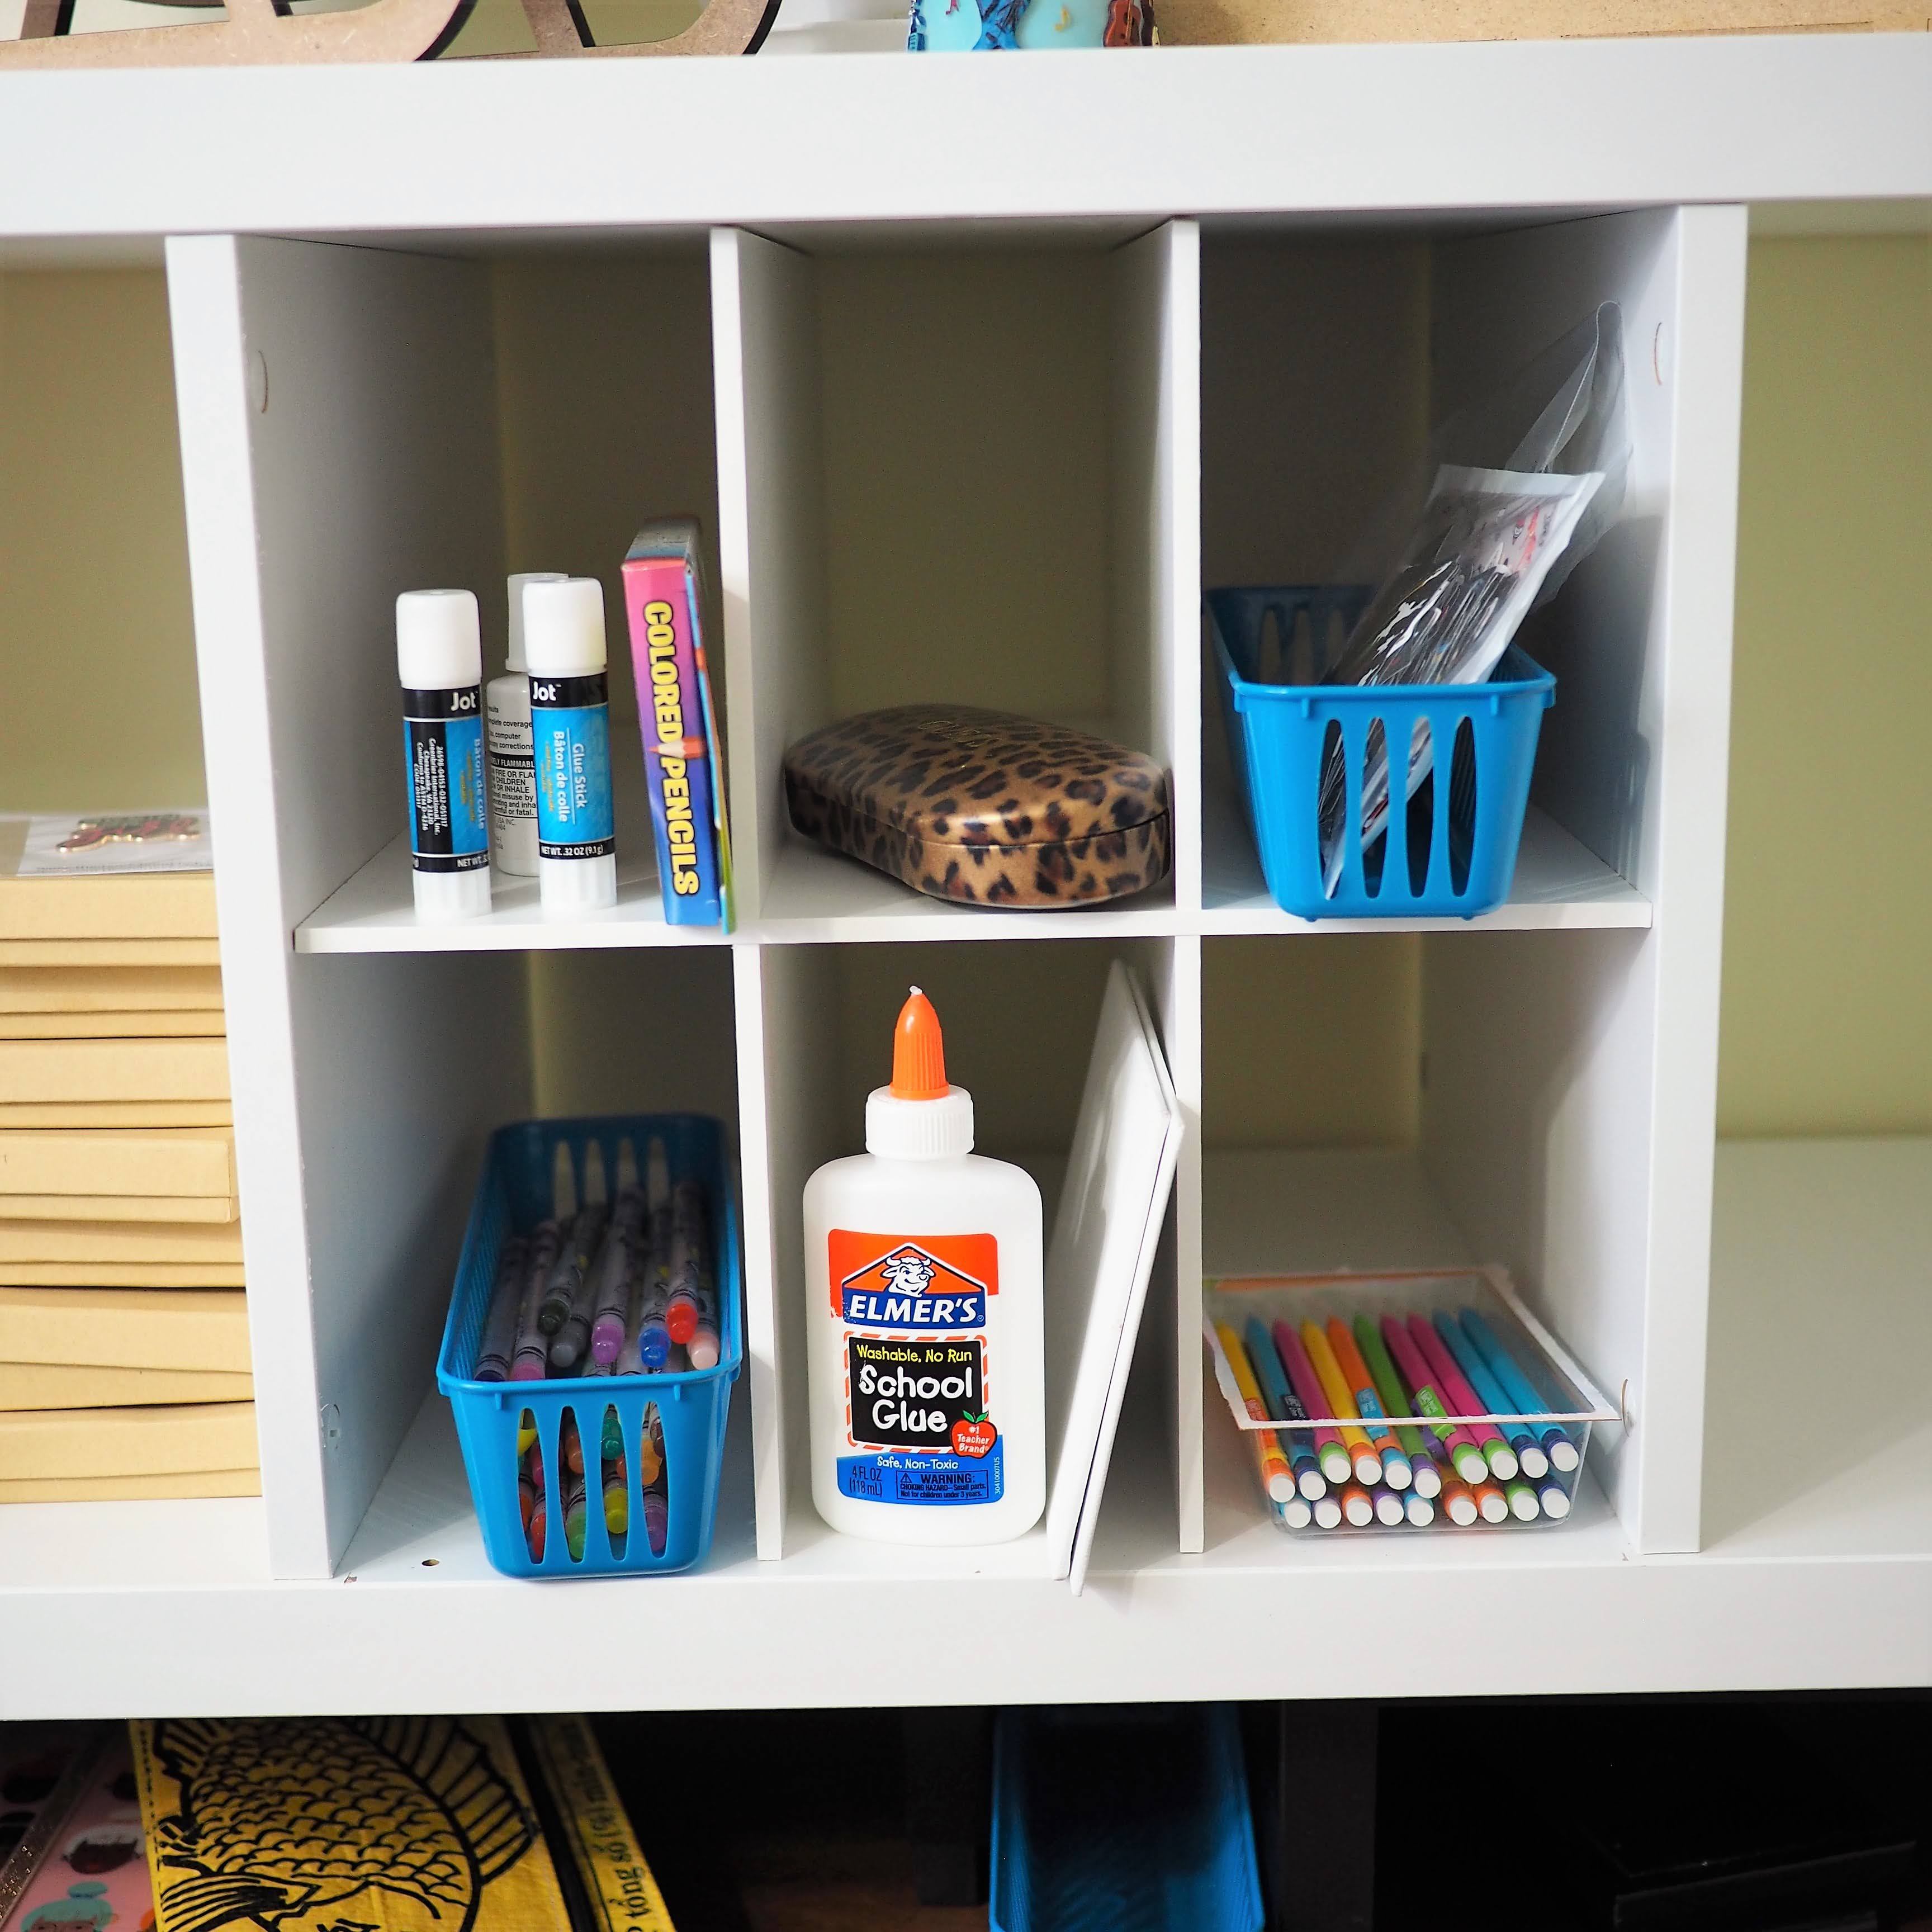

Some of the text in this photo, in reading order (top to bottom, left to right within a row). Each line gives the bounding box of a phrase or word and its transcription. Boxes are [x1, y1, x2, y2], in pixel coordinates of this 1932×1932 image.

[533, 681, 556, 701] Jot
[451, 692, 476, 711] Jot
[644, 600, 699, 896] COLORED PENCILS
[501, 759, 535, 768] FLAMMABL
[496, 776, 525, 786] CHILDREN
[553, 731, 570, 822] Bâton de colle
[572, 743, 588, 809] Glue Stick
[476, 780, 484, 793] de
[541, 846, 550, 854] NET
[574, 847, 585, 855] OZ
[849, 1294, 978, 1324] ELMER'S
[856, 1344, 972, 1363] Washable, No Run
[858, 1363, 973, 1399] School
[872, 1400, 948, 1433] Glue
[968, 1426, 980, 1434] #1
[956, 1433, 990, 1445] Teacher
[959, 1442, 986, 1453] Brand
[905, 1458, 959, 1470] Non-Toxic
[852, 1465, 882, 1481] 4 FL OZ
[921, 1473, 976, 1484] WARNING:
[849, 1477, 883, 1497] (118 mL)
[970, 1483, 987, 1491] parts.
